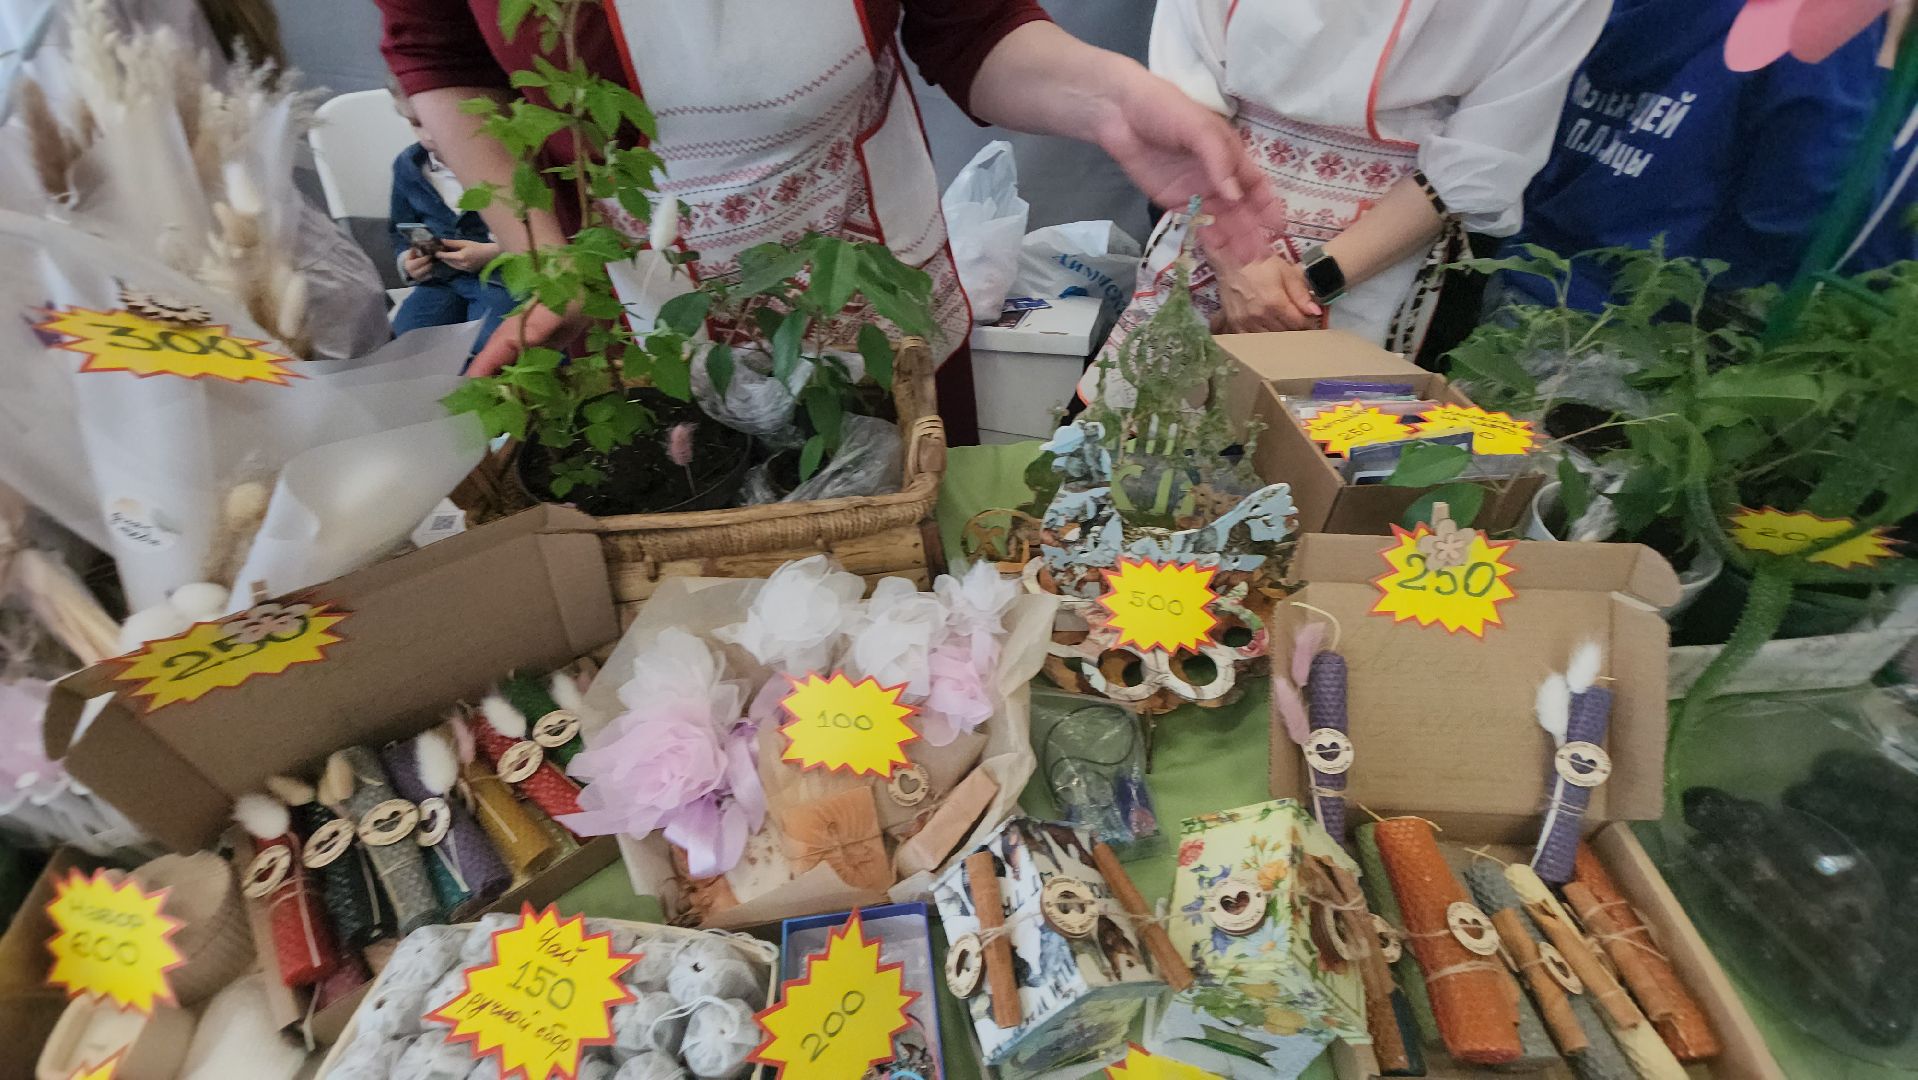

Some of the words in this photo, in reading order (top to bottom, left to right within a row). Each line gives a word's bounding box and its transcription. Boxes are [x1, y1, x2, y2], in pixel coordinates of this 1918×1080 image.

[88, 322, 255, 361] 300
[1337, 422, 1374, 441] 250
[1397, 553, 1497, 598] 250
[1129, 590, 1184, 616] 500
[816, 709, 874, 731] 100
[508, 960, 576, 1011] 150
[801, 990, 866, 1063] 200
